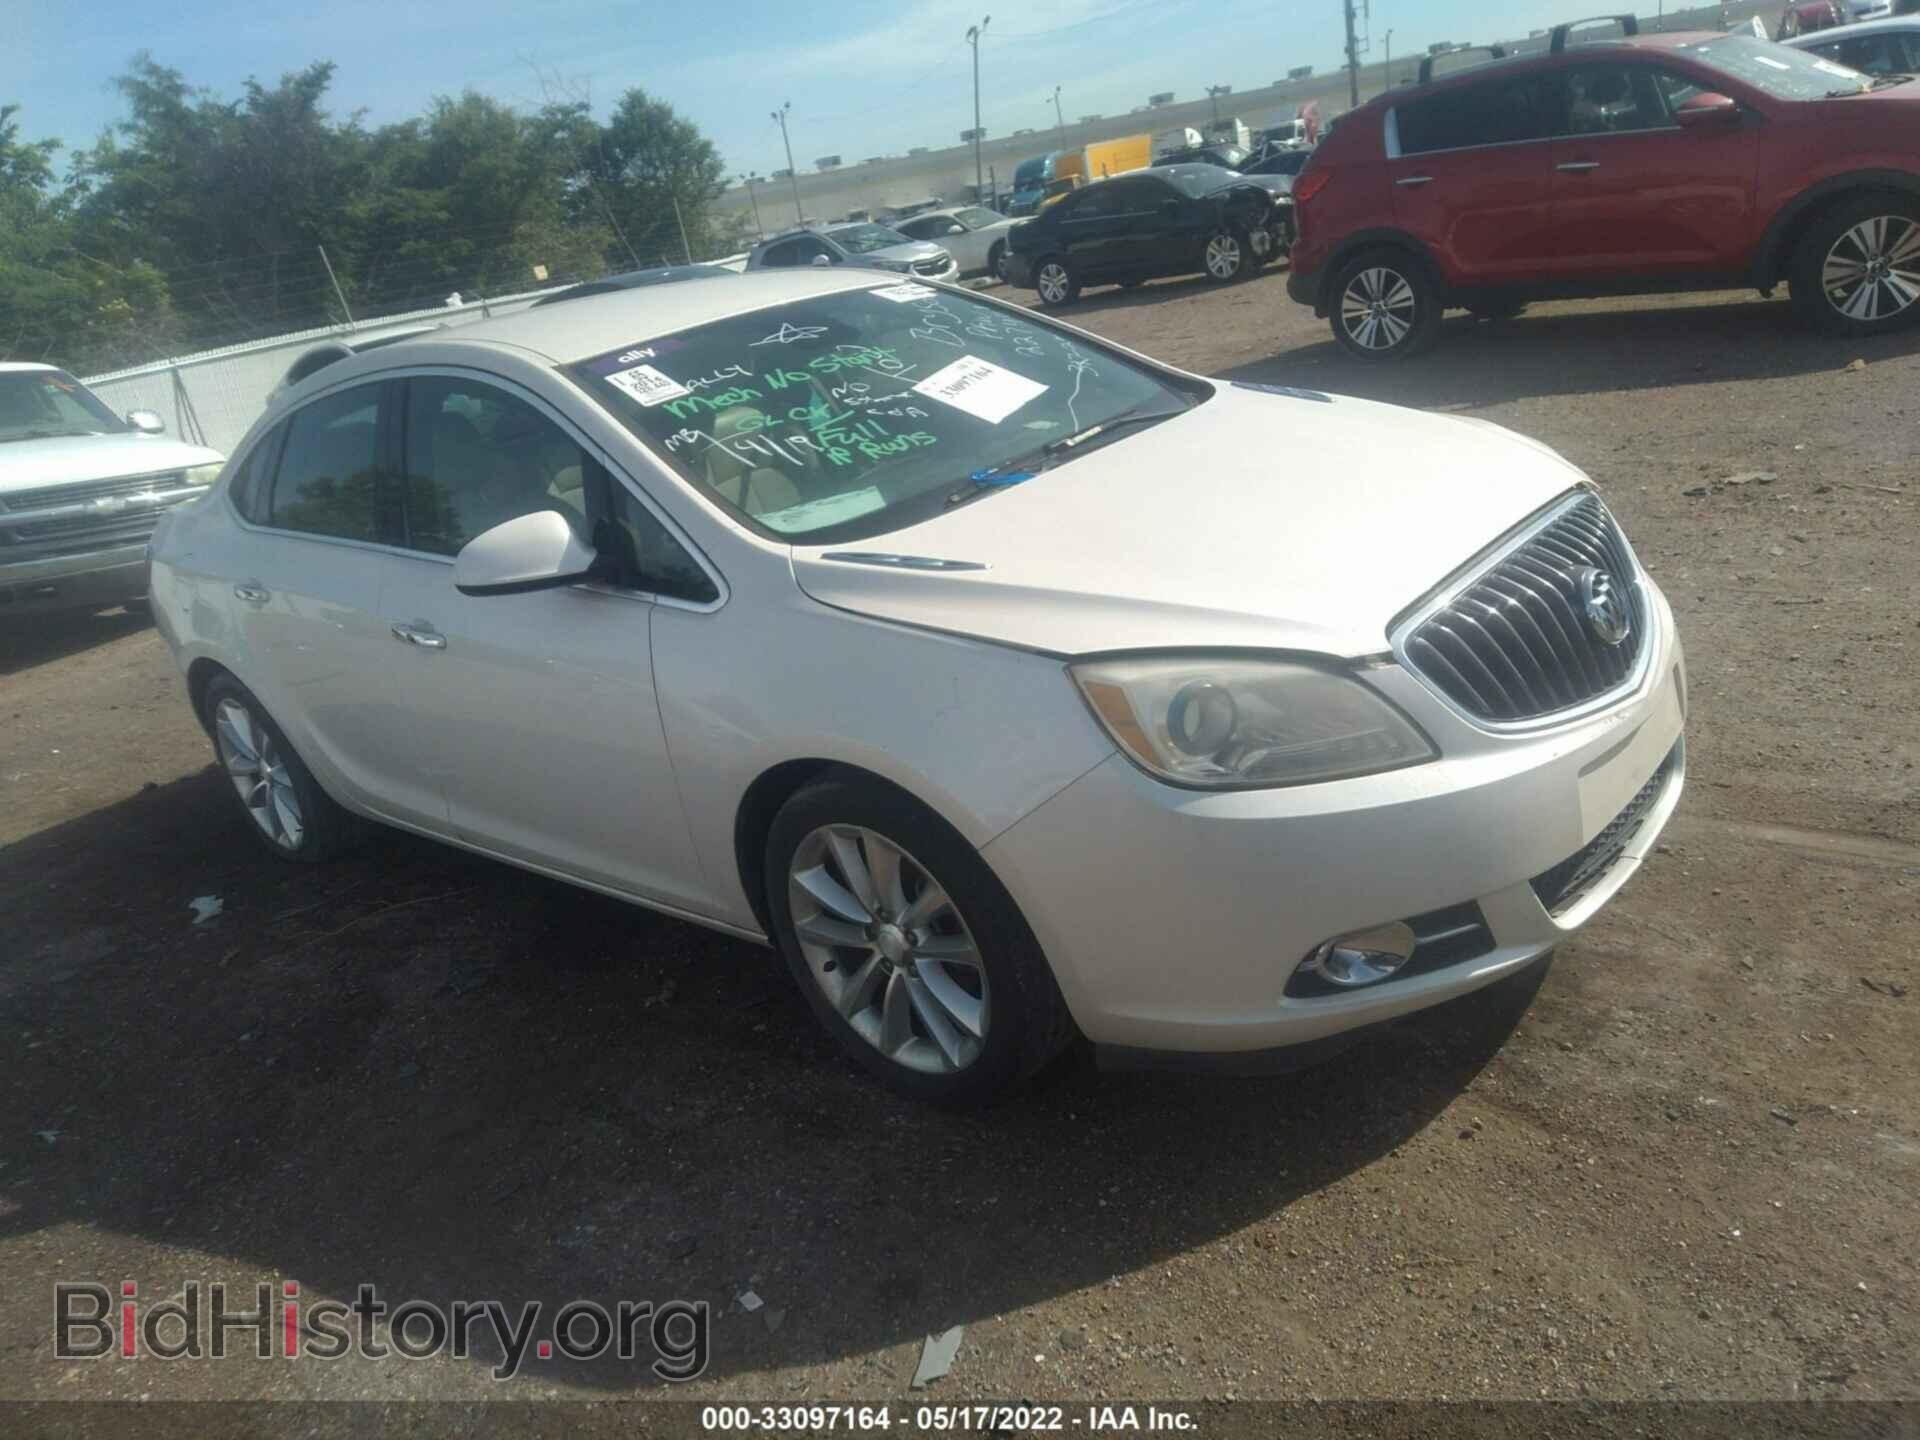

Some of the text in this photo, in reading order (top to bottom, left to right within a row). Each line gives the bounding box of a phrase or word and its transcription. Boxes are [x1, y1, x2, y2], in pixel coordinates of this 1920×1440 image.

[617, 347, 657, 363] ally
[662, 386, 763, 419] Mech
[815, 419, 890, 448] Full
